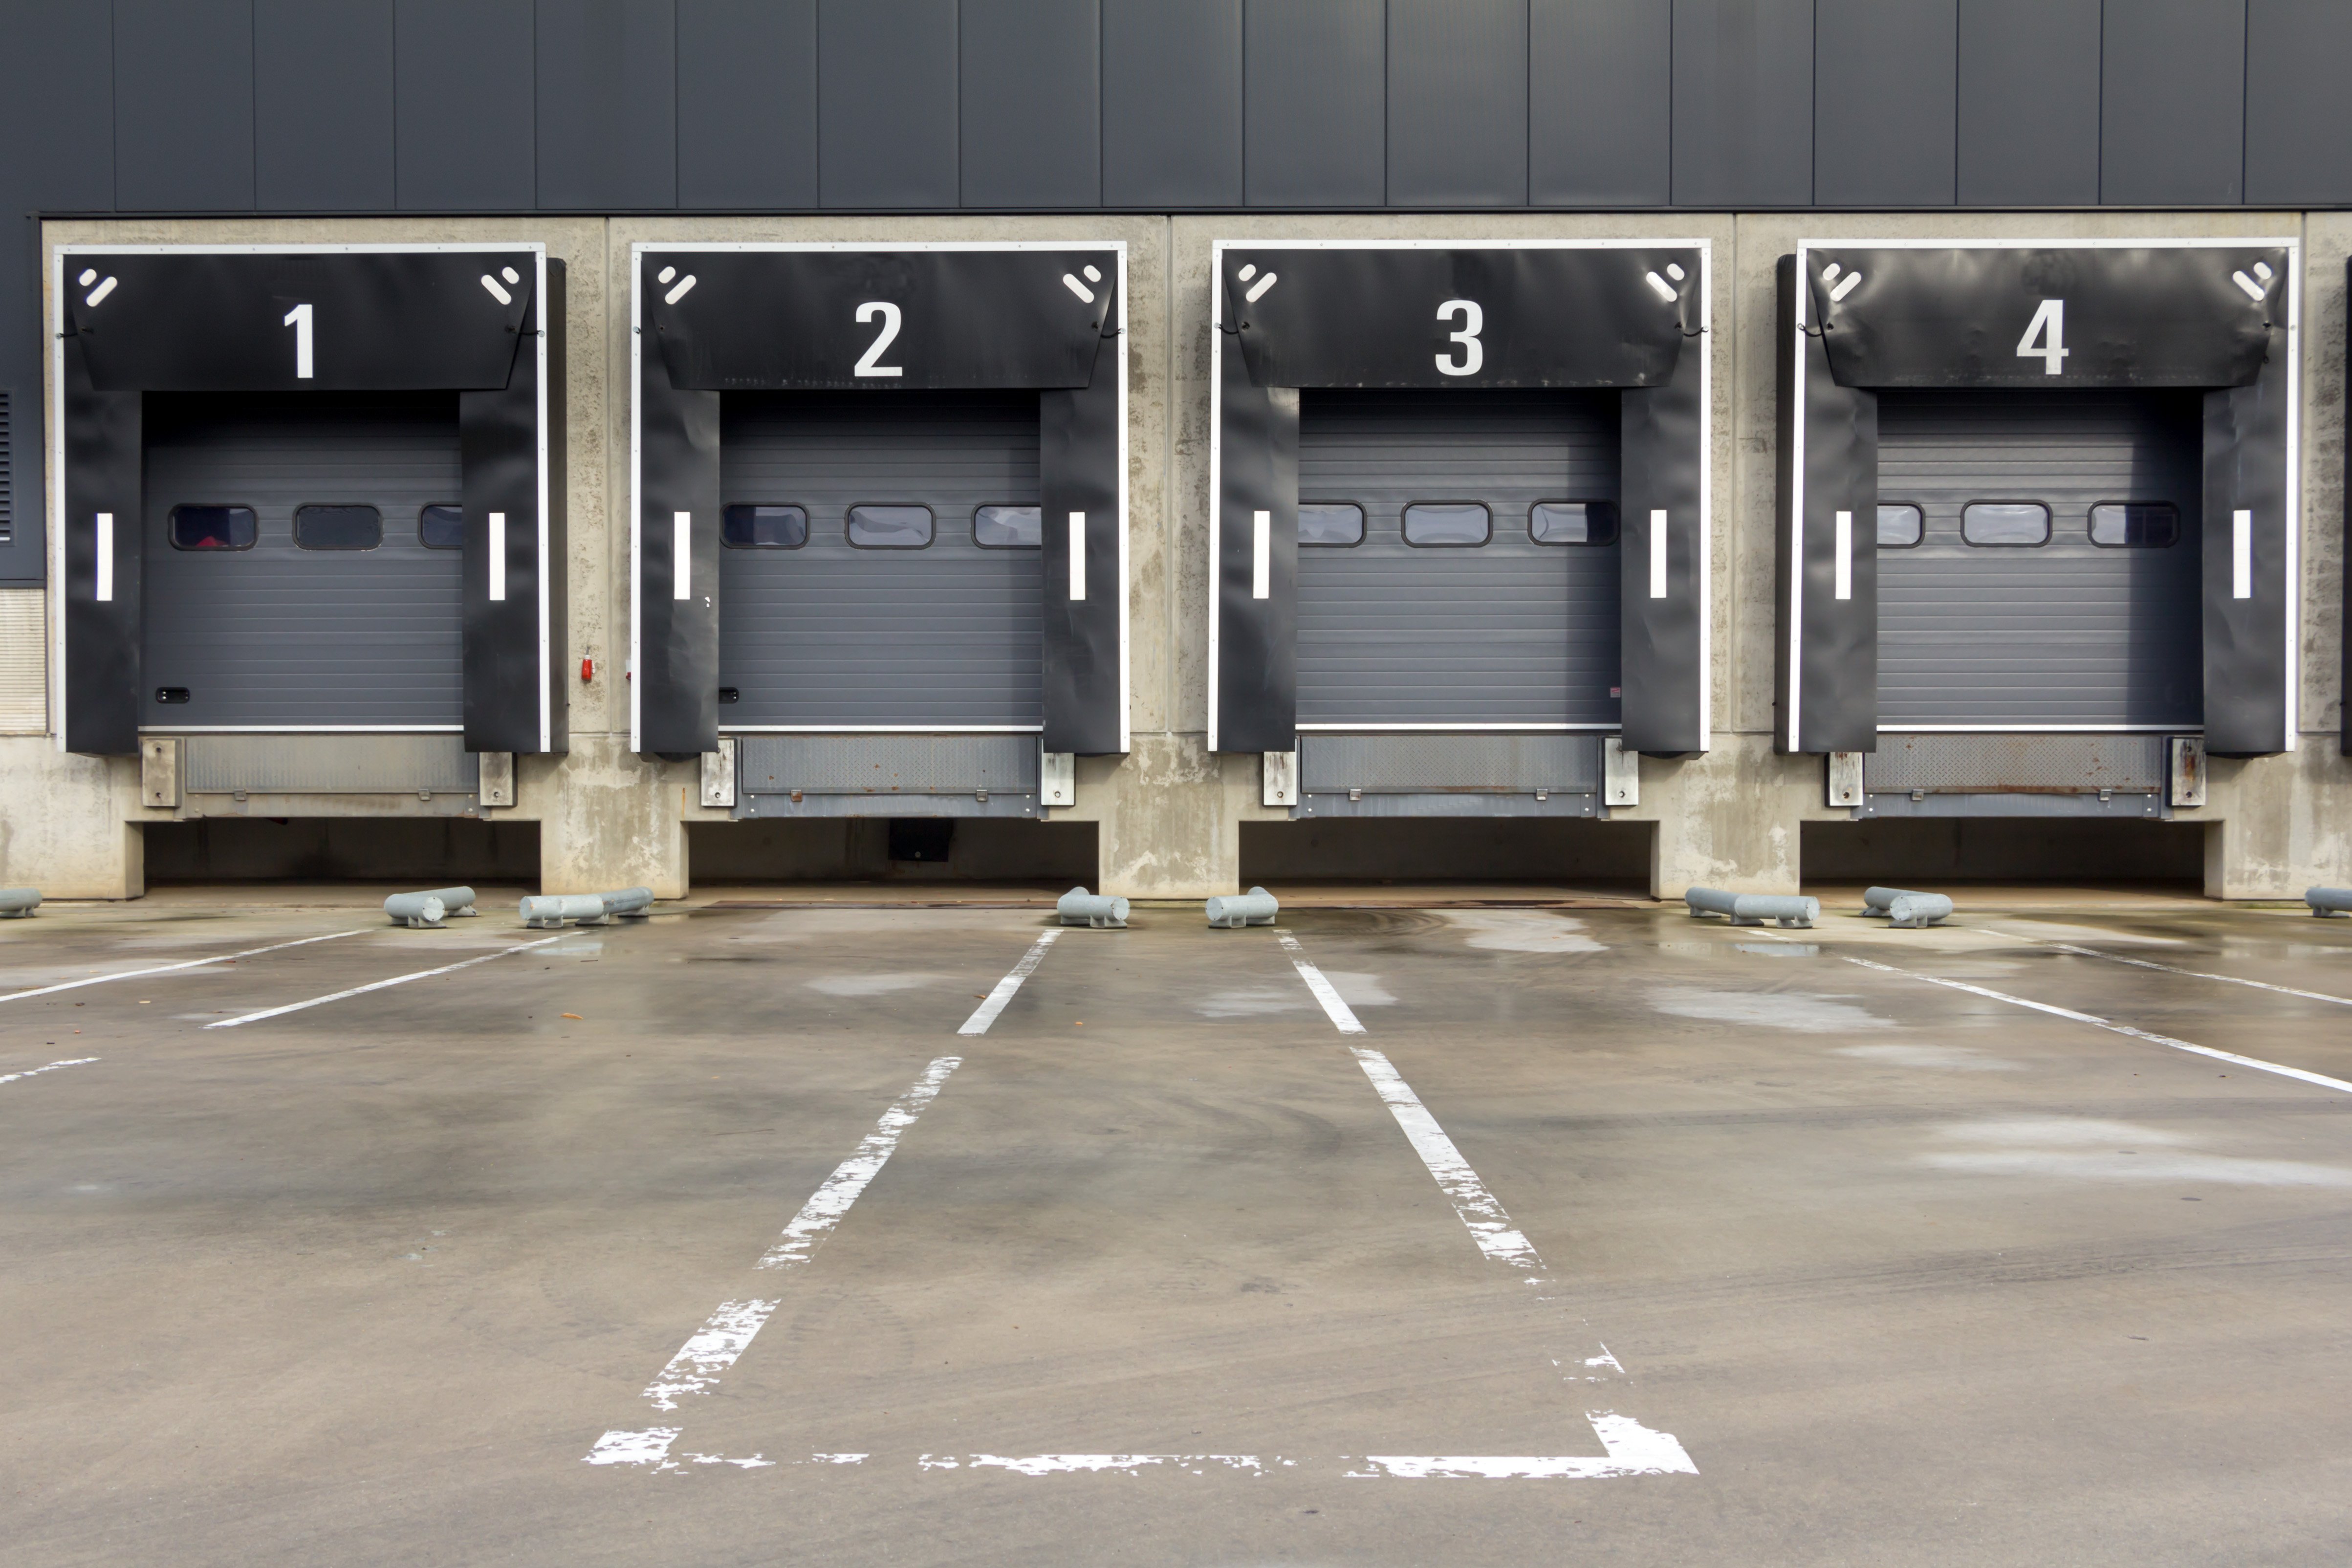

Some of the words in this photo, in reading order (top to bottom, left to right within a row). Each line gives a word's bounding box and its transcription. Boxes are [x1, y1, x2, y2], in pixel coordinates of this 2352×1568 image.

[284, 304, 313, 378] 1
[854, 302, 903, 377] 2
[1435, 300, 1483, 376] 3
[2017, 300, 2069, 375] 4
